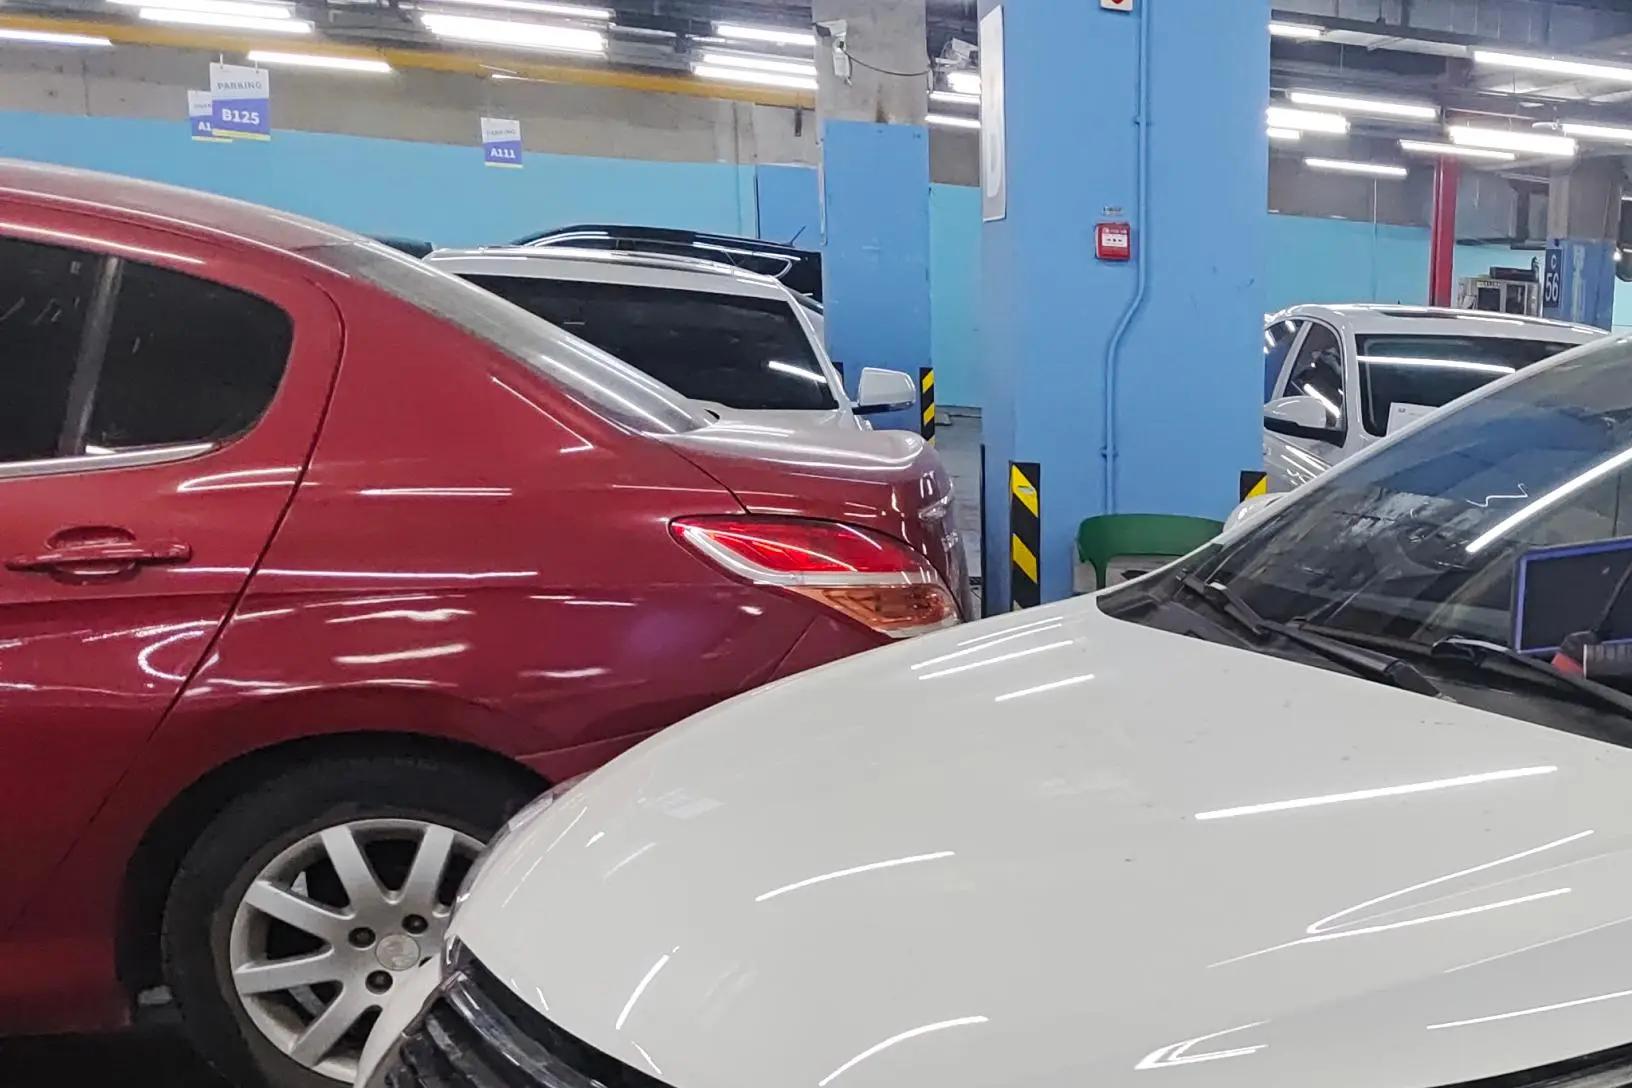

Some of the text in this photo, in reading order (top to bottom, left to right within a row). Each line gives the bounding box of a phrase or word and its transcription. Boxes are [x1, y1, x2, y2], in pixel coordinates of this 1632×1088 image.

[222, 108, 260, 125] B125
[490, 147, 517, 159] A111
[1550, 253, 1557, 270] C
[1545, 272, 1560, 302] 56
